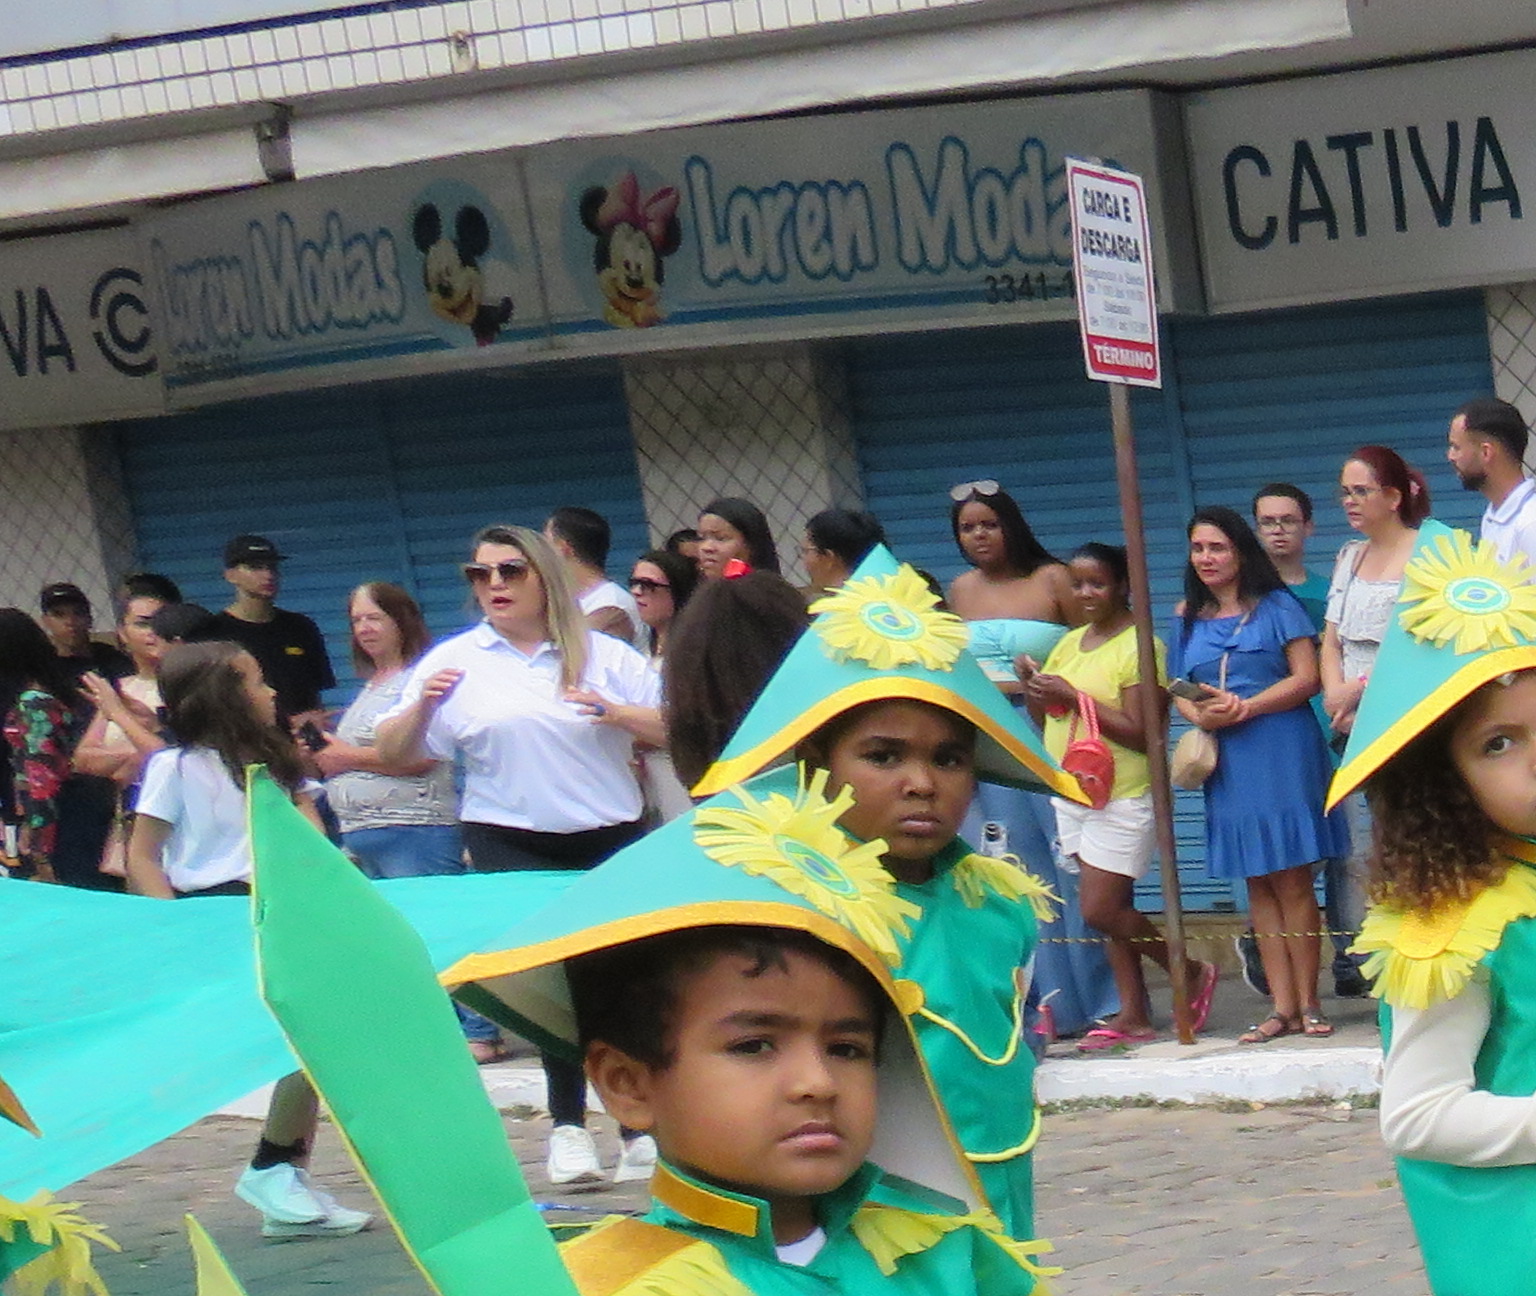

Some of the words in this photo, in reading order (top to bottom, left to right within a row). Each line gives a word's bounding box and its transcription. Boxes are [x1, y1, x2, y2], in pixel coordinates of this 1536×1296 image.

[684, 154, 879, 288] Loren
[886, 135, 1120, 273] Moda
[1082, 187, 1121, 221] CARGA
[1123, 199, 1132, 223] E
[1222, 116, 1523, 251] CATIVA
[247, 210, 405, 341] Modas
[1080, 227, 1142, 264] DESCARGA
[1093, 342, 1154, 370] TÉRMINO
